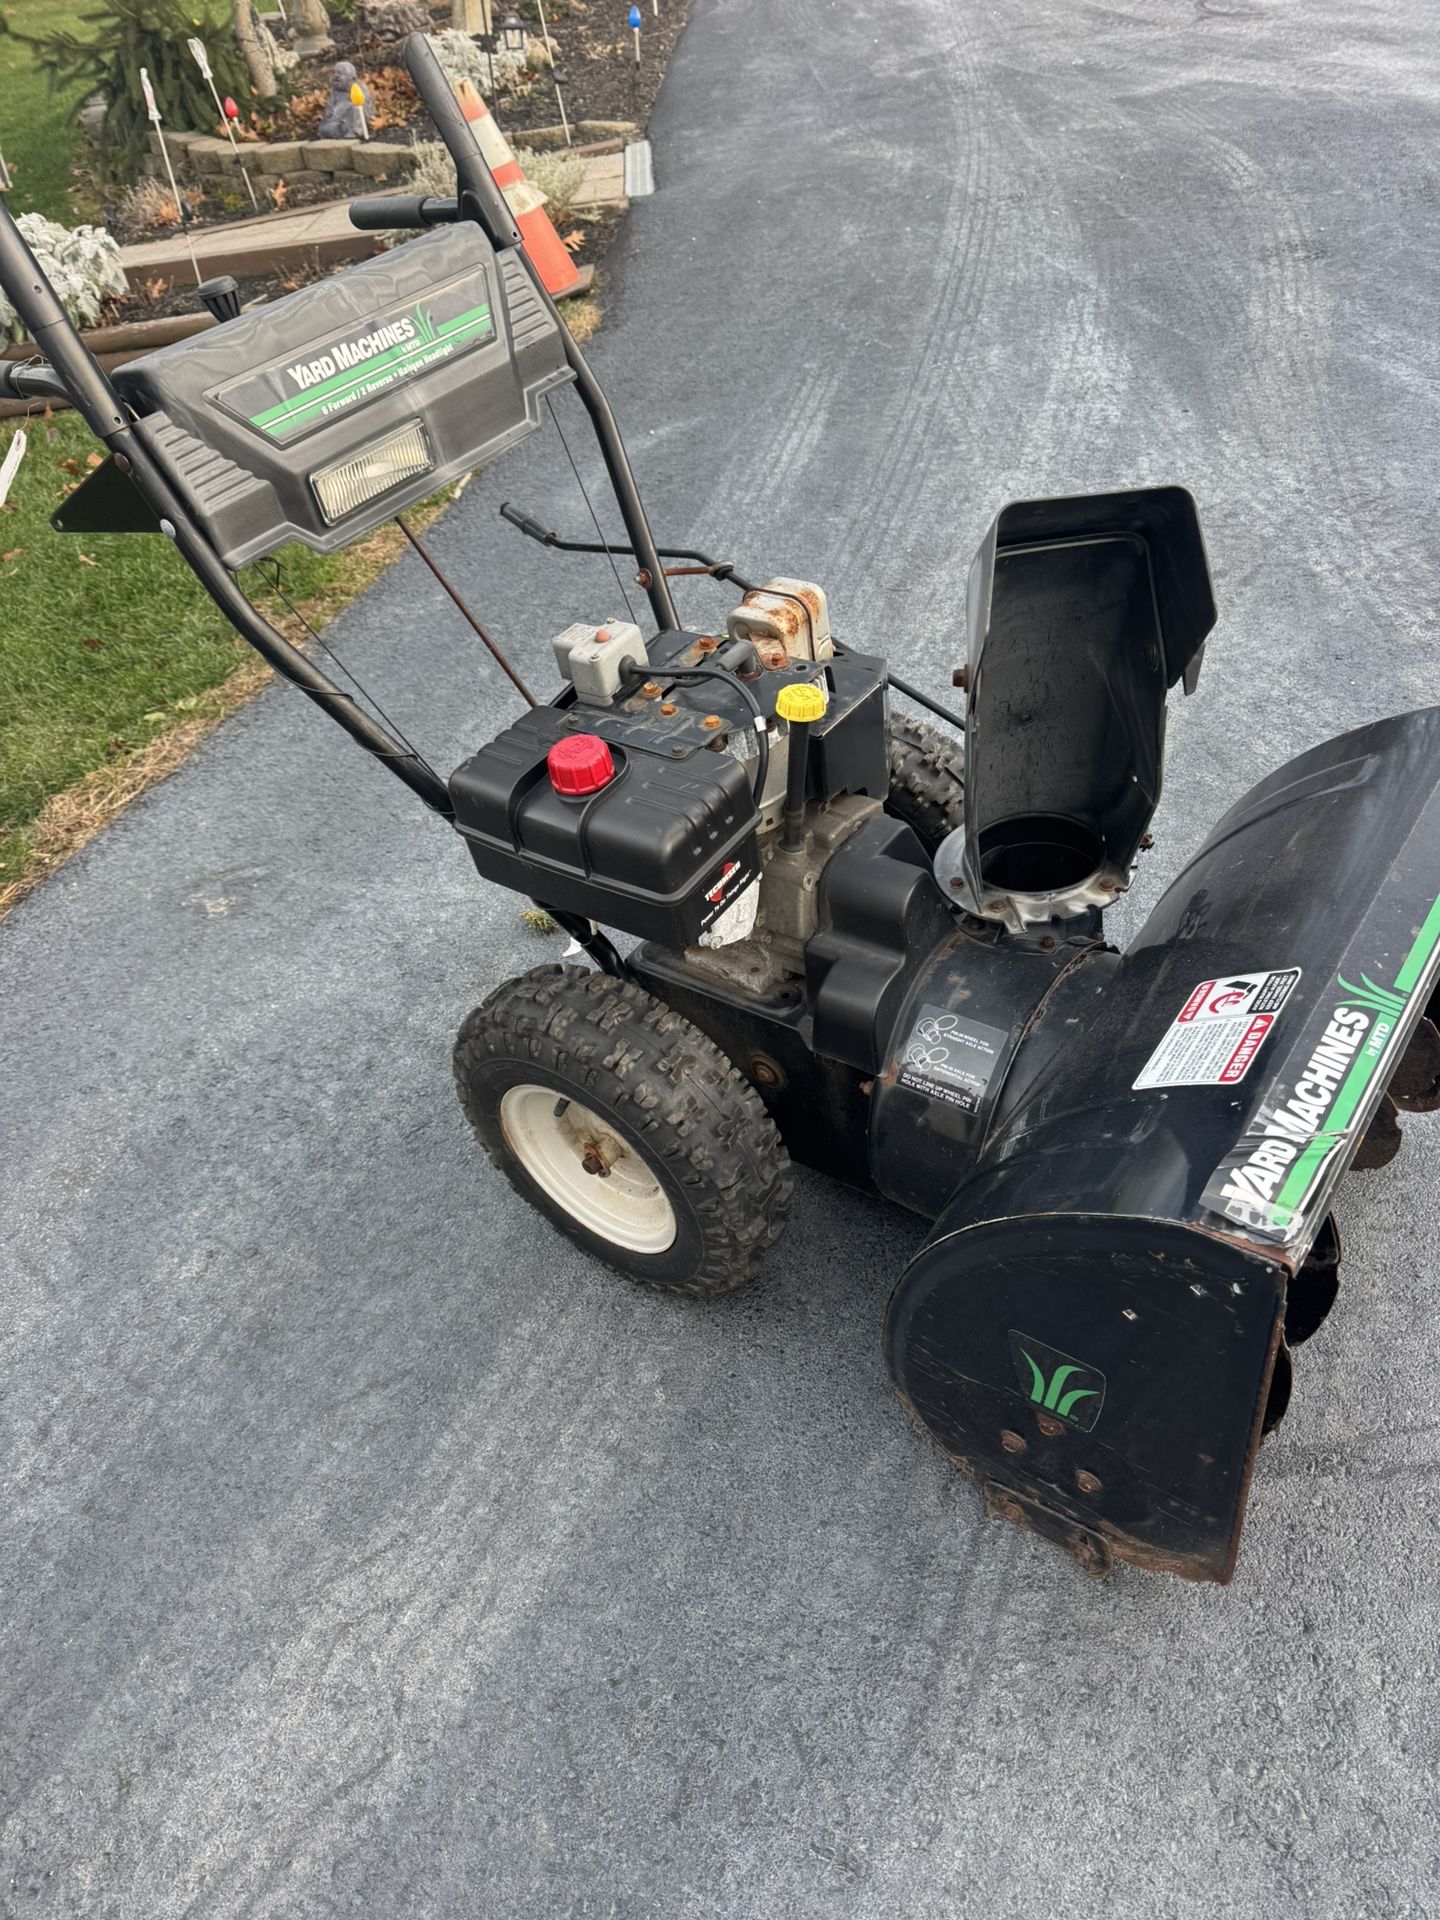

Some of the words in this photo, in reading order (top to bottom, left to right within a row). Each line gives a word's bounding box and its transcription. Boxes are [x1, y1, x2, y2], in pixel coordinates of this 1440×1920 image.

[286, 356, 336, 390] YARD
[331, 317, 415, 371] MACHINES
[328, 392, 357, 412] Forward
[361, 387, 367, 396] 2
[366, 374, 393, 392] Reverse
[423, 343, 454, 364] Headlight
[704, 861, 741, 902] TECUMSEH
[977, 1045, 994, 1054] ACTION
[1364, 1046, 1379, 1057] by
[1368, 1022, 1390, 1049] MTD
[1223, 1031, 1264, 1078] DANGER
[901, 1078, 916, 1087] HOLE
[916, 1083, 930, 1092] WITH
[930, 1089, 945, 1098] AXLE
[945, 1094, 955, 1102] PIN
[955, 1099, 971, 1109] HOLE
[911, 1075, 922, 1083] NOT
[922, 1080, 935, 1089] LINE
[943, 1088, 961, 1099] WHEEL
[962, 1095, 972, 1103] PIN
[1220, 1139, 1298, 1208] YARD
[1264, 1007, 1370, 1144] MACHINES
